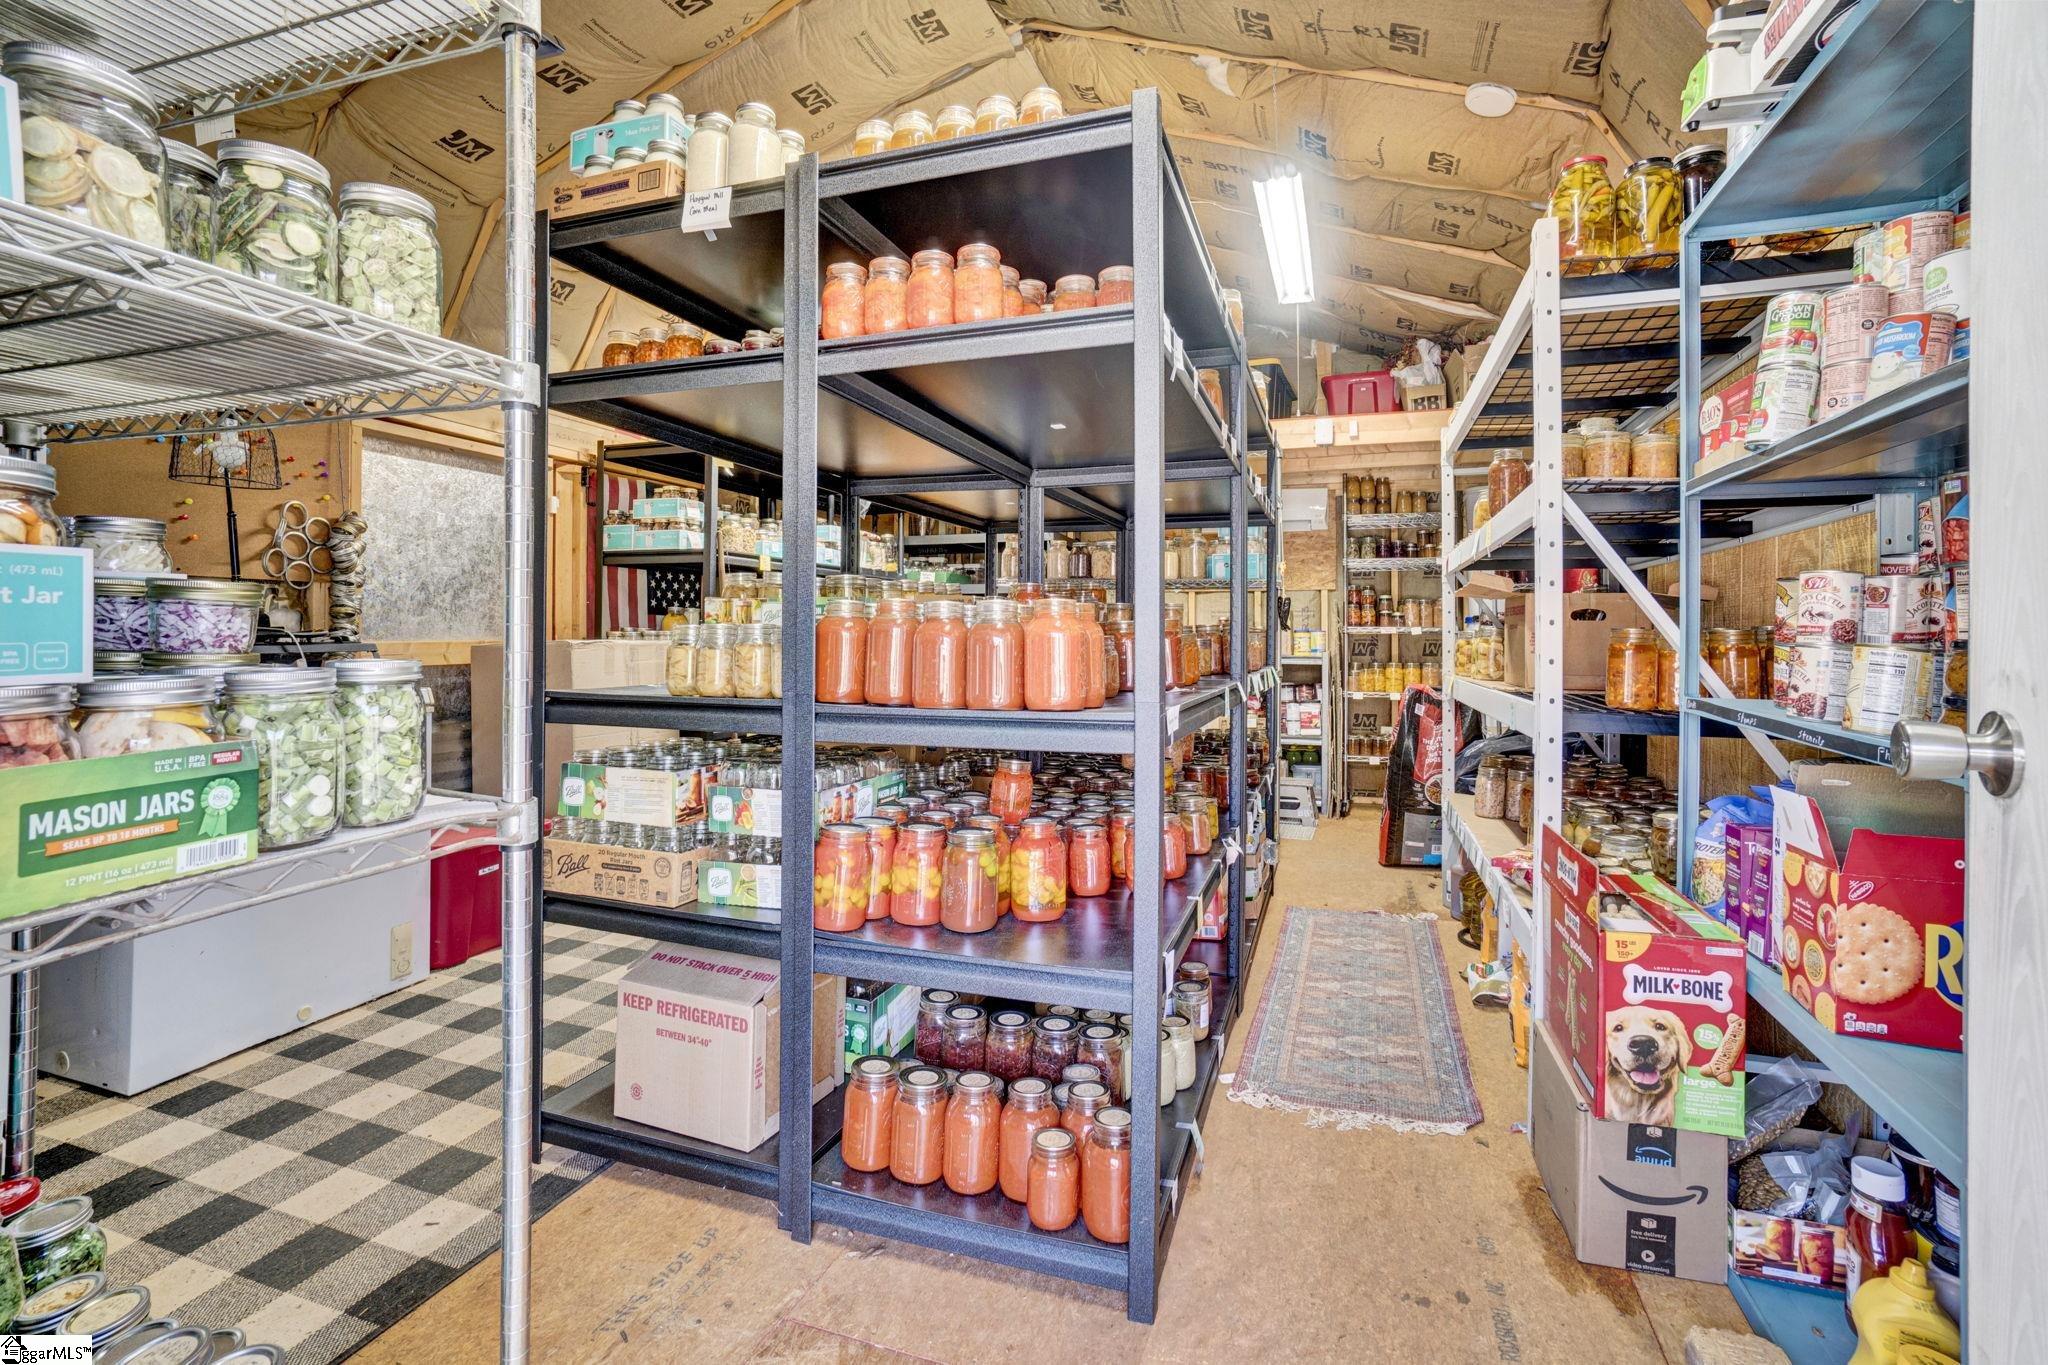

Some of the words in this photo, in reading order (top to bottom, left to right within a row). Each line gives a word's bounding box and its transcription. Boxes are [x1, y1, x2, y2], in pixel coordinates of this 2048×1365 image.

[910, 9, 950, 44] JM
[1240, 8, 1274, 41] JM
[1571, 41, 1605, 77] JM
[536, 62, 590, 95] JM
[791, 82, 833, 116] JM
[439, 129, 496, 162] JM
[9, 564, 37, 576] (473
[21, 585, 64, 605] Jar
[1352, 713, 1378, 727] JM
[154, 758, 174, 767] MADE
[188, 755, 206, 764] BPA
[213, 750, 241, 760] REGULAR
[154, 763, 183, 773] U.S.A.
[215, 755, 238, 764] MOUTH
[565, 784, 583, 798] Ball
[28, 802, 127, 841] MASON
[133, 789, 195, 822] JARS
[62, 837, 93, 851] SEALS
[93, 834, 106, 846] UP
[106, 832, 119, 844] TO
[119, 830, 130, 841] 18
[131, 823, 166, 839] MONTHS
[557, 853, 592, 879] Ball
[606, 850, 627, 859] Regular
[628, 852, 647, 860] Mouth
[65, 878, 78, 888] 12
[79, 871, 105, 885] PINT
[120, 868, 133, 876] oz
[140, 860, 158, 872] 473
[710, 872, 730, 889] Ball
[1615, 940, 1629, 949] 15
[650, 952, 667, 962] DO
[666, 953, 687, 966] NOT
[686, 957, 716, 973] STACK
[714, 964, 742, 978] OVER
[742, 969, 752, 981] 5
[751, 971, 779, 983] HIGH
[1633, 975, 1675, 995] MILK
[1681, 979, 1724, 1002] BONE
[622, 991, 654, 1012] KEEP
[655, 999, 749, 1035] REFRIGERATED
[655, 1027, 686, 1043] BETWEEN
[1683, 1075, 1717, 1089] large
[1630, 1229, 1644, 1237] free
[1644, 1231, 1668, 1240] delivery
[1626, 1262, 1642, 1270] video
[1642, 1264, 1670, 1274] streaming
